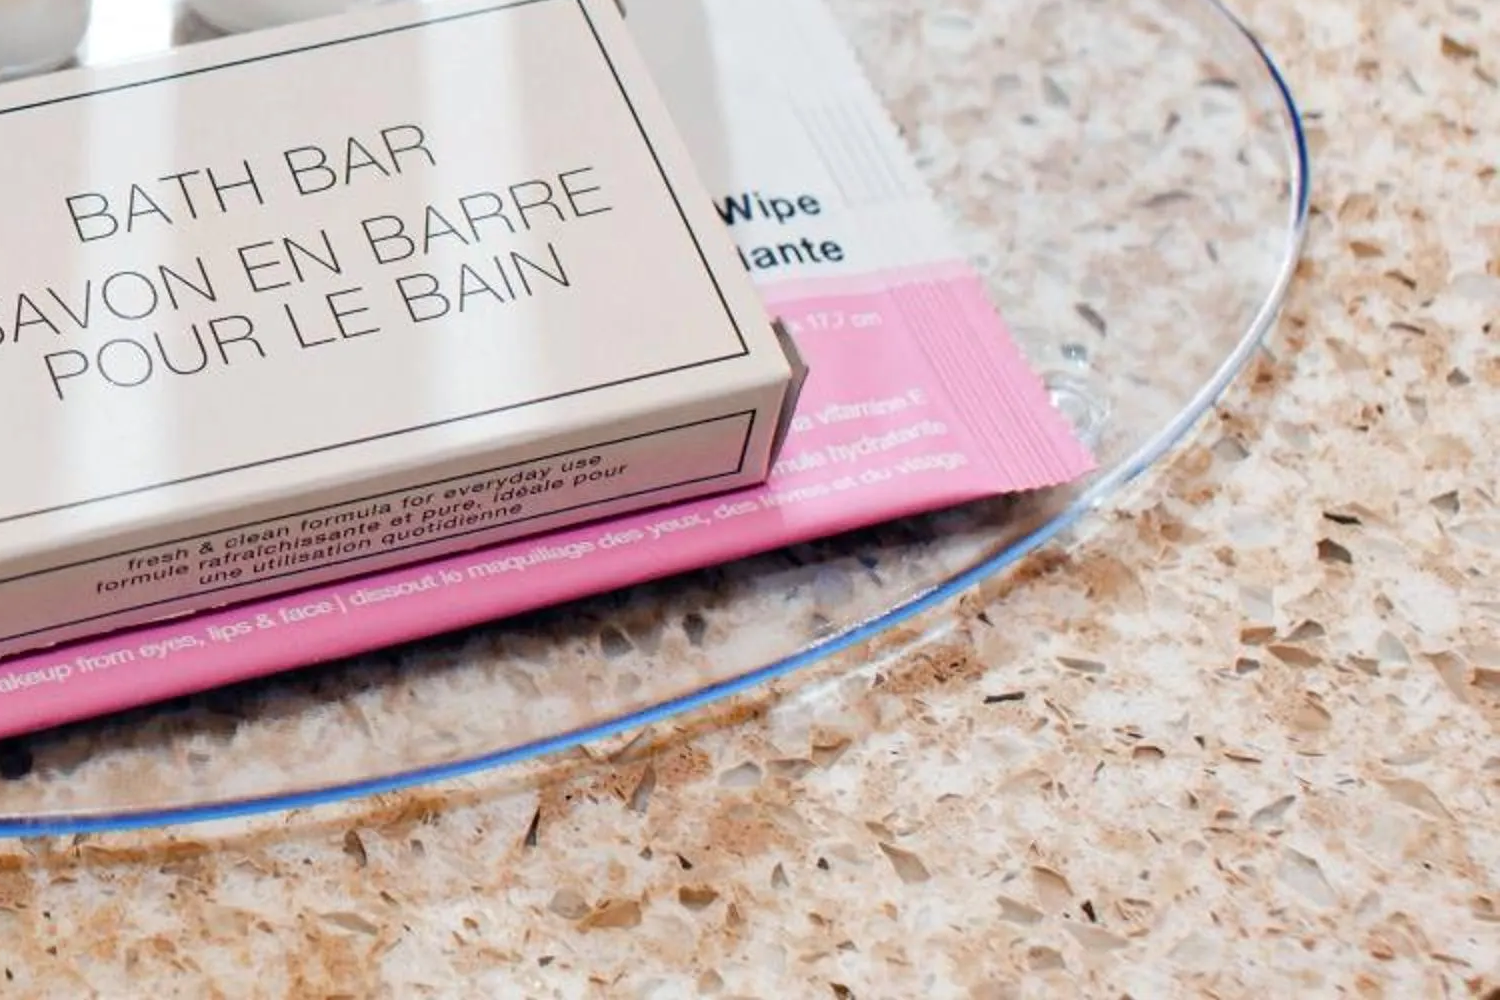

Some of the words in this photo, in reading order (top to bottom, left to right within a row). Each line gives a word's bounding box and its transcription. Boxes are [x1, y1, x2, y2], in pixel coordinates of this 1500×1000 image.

[65, 158, 264, 244] BATH
[283, 123, 437, 196] BAR
[237, 228, 341, 293] EN
[361, 166, 613, 265] BARRE
[712, 190, 822, 226] Wipe
[43, 313, 266, 401] POUR
[284, 287, 381, 349] LE
[396, 242, 571, 324] BAIN
[75, 645, 135, 675] from
[207, 618, 253, 644] lips
[255, 612, 277, 630] &
[278, 598, 333, 625] face
[348, 575, 438, 607] dissout
[440, 561, 463, 585] le
[467, 538, 596, 580] maquillage
[598, 526, 645, 549] des
[858, 467, 892, 486] du
[96, 564, 190, 595] formule
[389, 511, 413, 527] et
[572, 463, 630, 488] pour
[128, 547, 190, 572] fresh
[198, 541, 214, 555] &
[224, 525, 290, 549] clean
[300, 500, 392, 531] formula
[402, 490, 435, 510] for
[443, 465, 552, 499] everyday
[560, 453, 603, 473] use
[198, 566, 243, 585] une
[252, 535, 372, 574] utilisation
[380, 502, 524, 546] quotidienne
